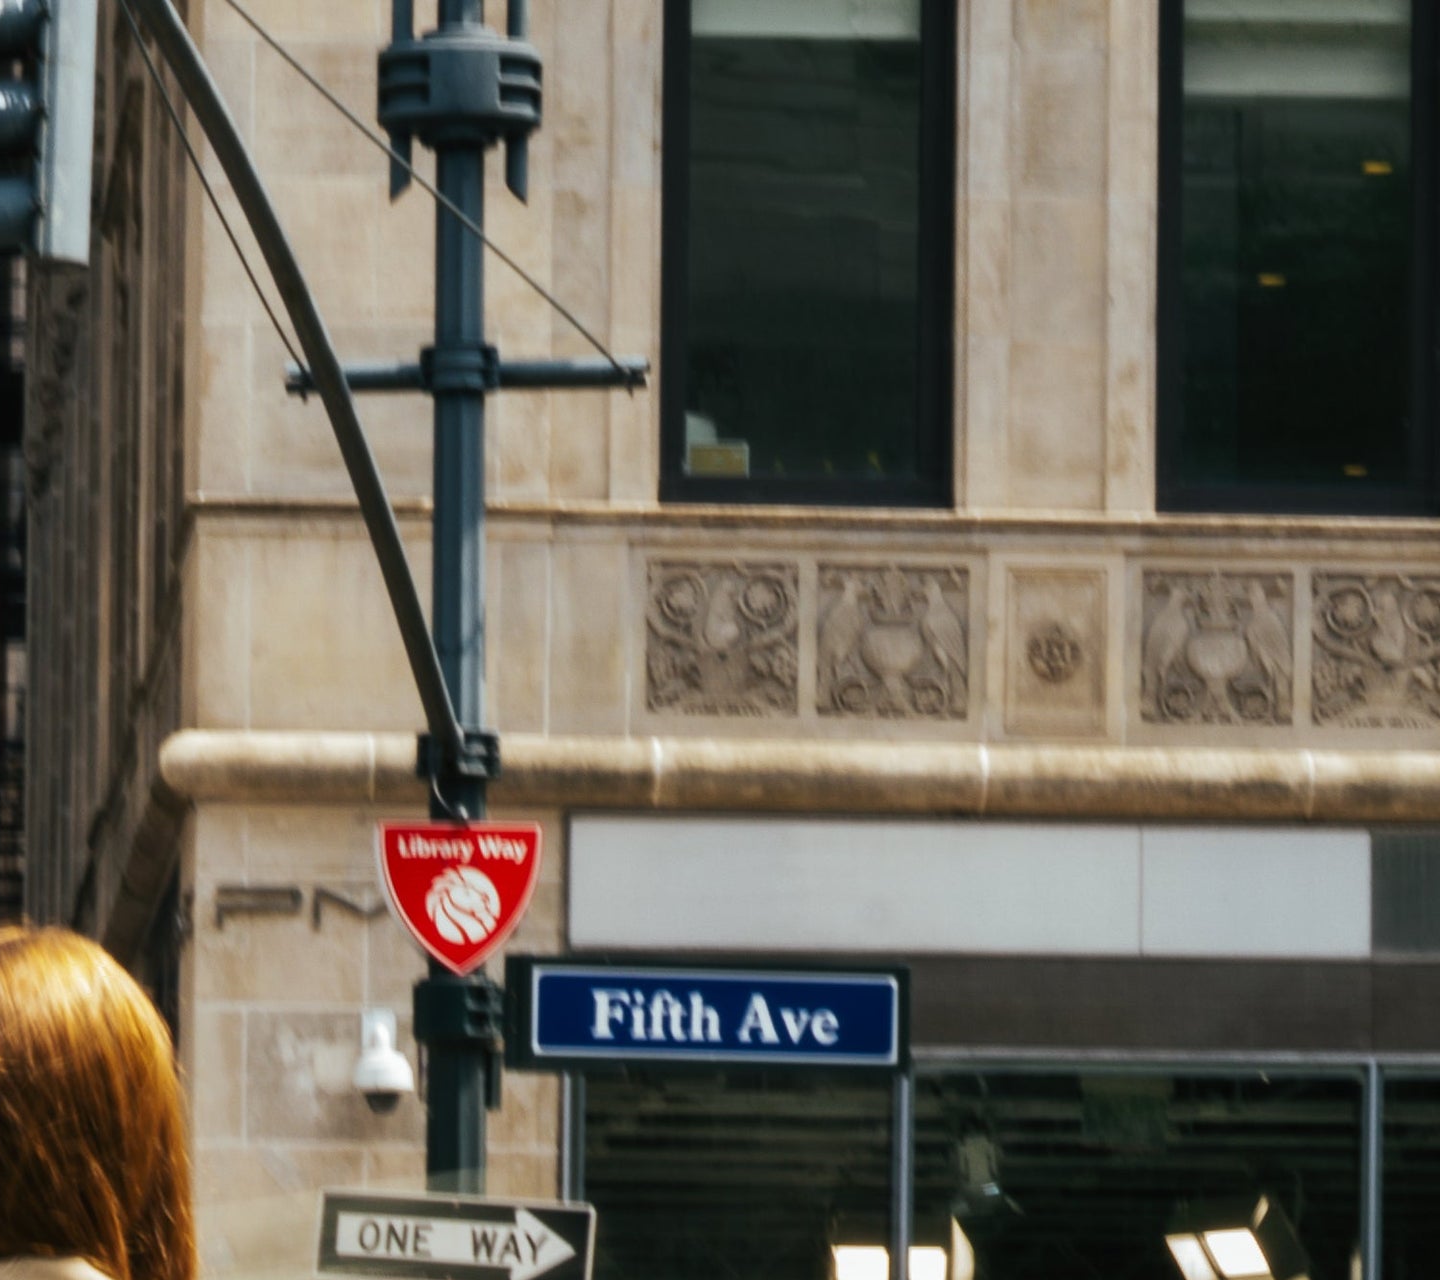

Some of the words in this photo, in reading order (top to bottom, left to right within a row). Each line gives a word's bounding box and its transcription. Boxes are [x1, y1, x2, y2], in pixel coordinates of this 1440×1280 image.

[397, 833, 474, 864] Library
[477, 833, 528, 866] Way
[590, 986, 722, 1042] Fifth
[737, 992, 840, 1046] Ave
[358, 1218, 433, 1259] ONE
[470, 1224, 548, 1266] WAY
